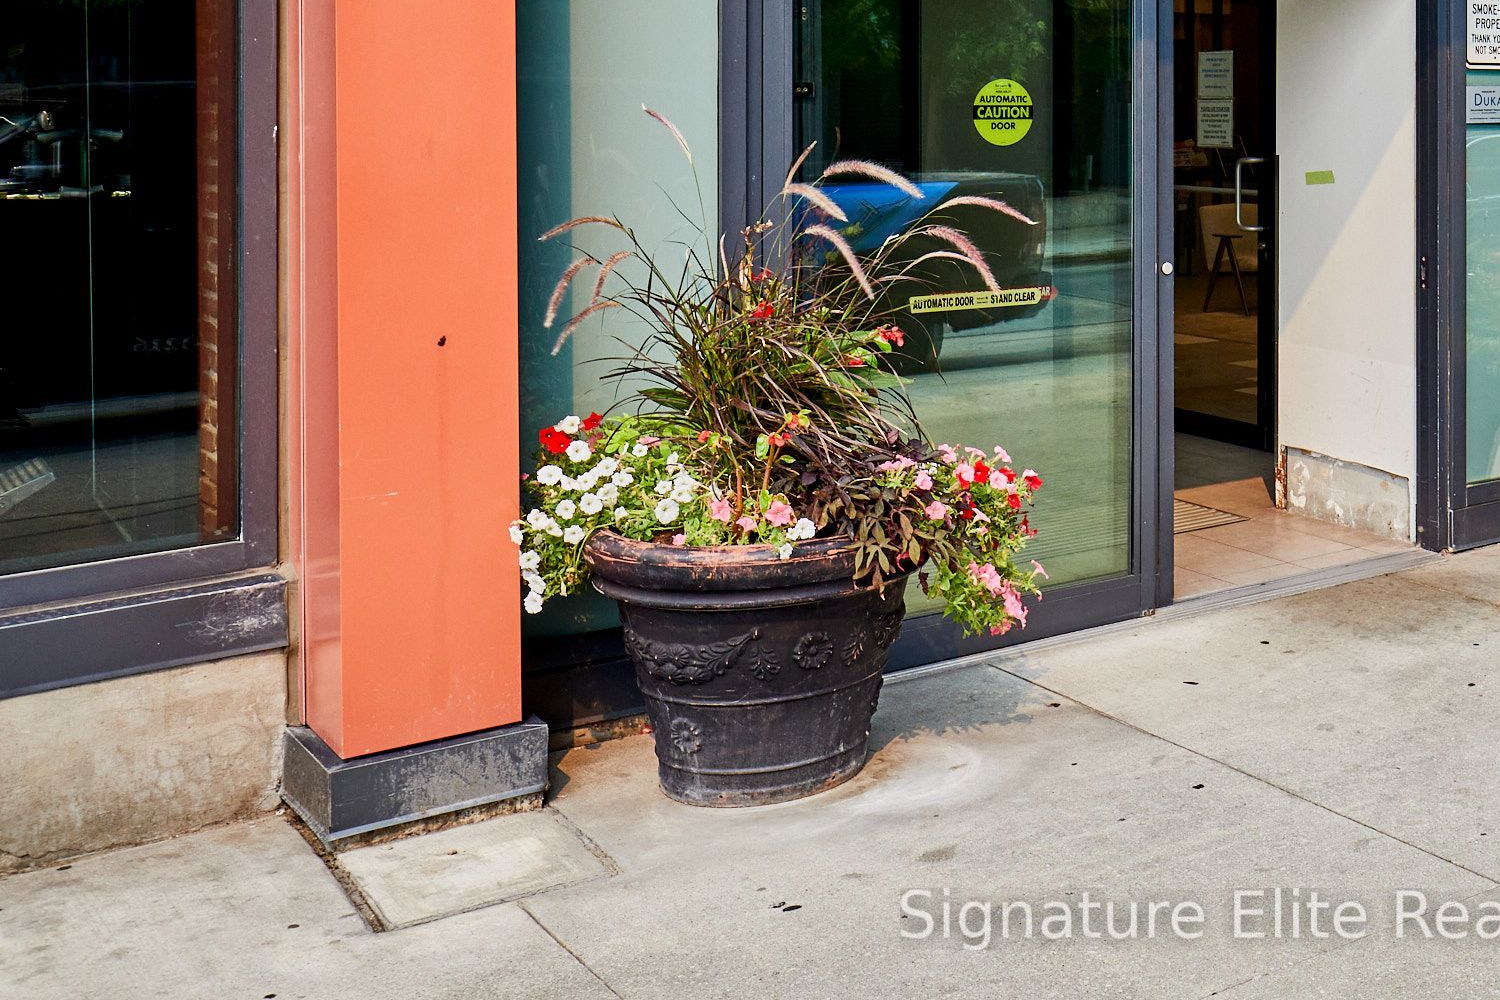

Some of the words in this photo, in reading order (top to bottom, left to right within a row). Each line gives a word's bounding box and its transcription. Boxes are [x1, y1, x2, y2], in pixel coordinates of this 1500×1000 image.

[1471, 33, 1491, 43] THANK
[1475, 45, 1487, 55] NOT
[979, 95, 1027, 103] AUTOMATIC
[977, 106, 1030, 118] CAUTION
[991, 122, 1016, 130] DOOR
[912, 297, 954, 310] AUTOMATIC
[955, 296, 975, 306] DOOR
[990, 292, 1013, 304] STAND
[1014, 291, 1036, 302] CLEAR
